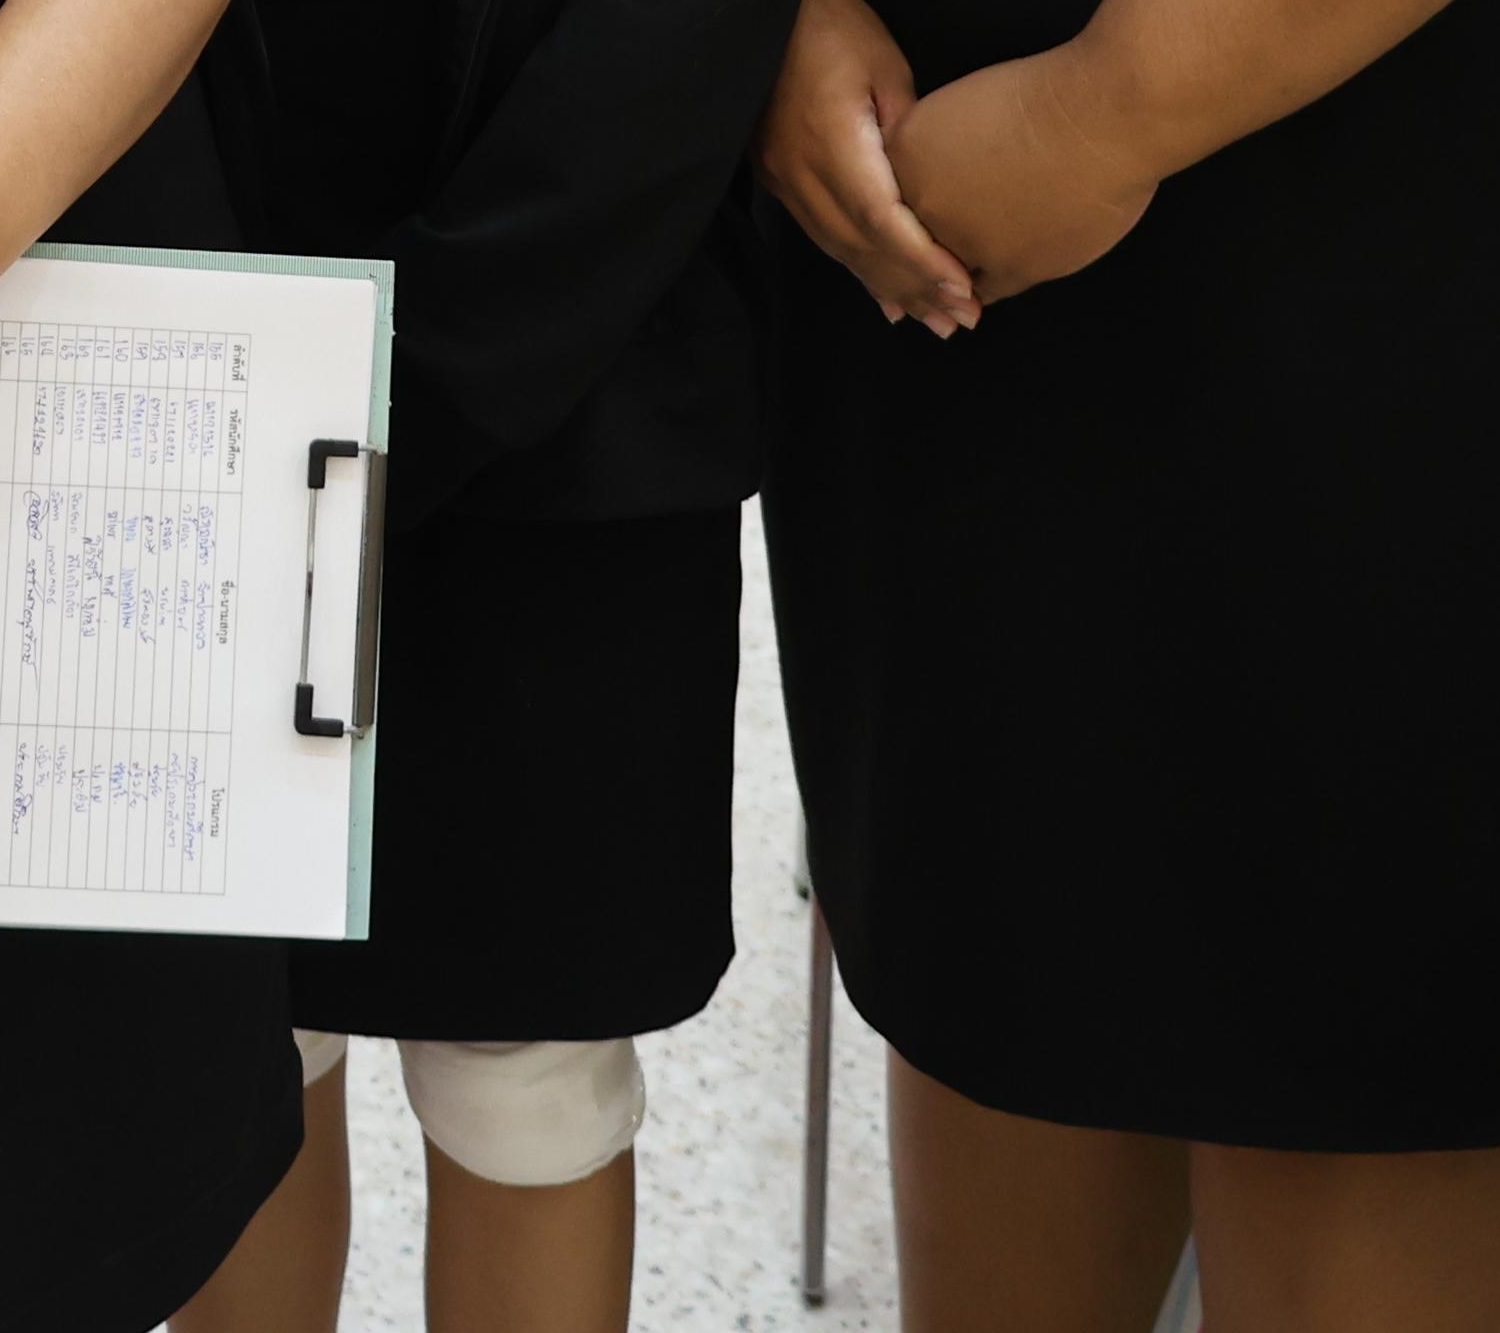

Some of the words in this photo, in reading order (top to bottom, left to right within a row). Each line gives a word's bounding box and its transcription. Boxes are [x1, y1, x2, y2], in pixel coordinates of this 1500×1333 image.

[231, 344, 245, 381] ลำดับที่
[226, 409, 241, 475] รหัสนักศึกษา
[215, 580, 234, 644] ชื่อ-นามสกุล
[209, 788, 224, 837] โปรแกรม
